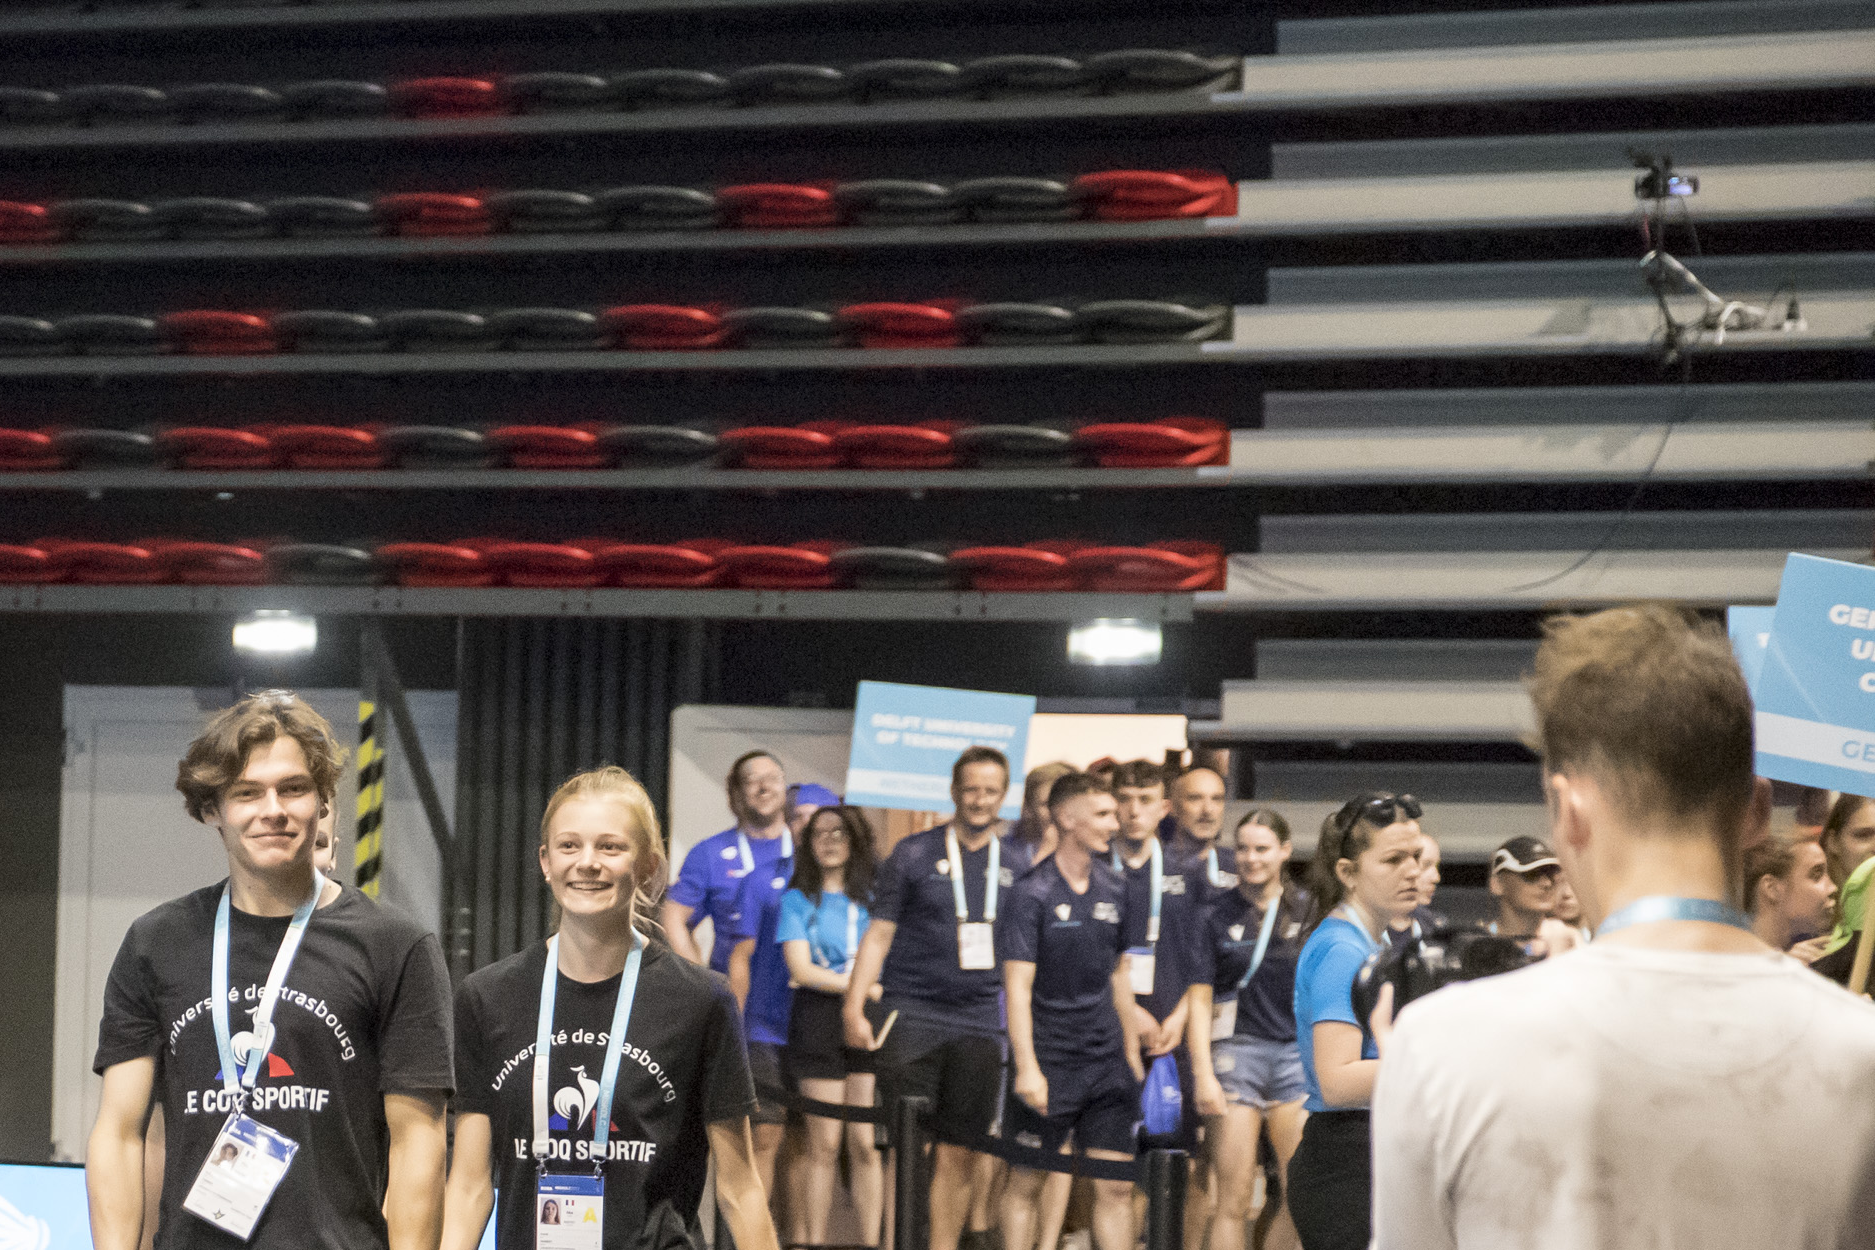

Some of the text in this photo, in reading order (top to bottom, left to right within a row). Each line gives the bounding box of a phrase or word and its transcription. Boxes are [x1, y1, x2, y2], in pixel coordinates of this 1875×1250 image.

[1828, 603, 1875, 631] GE
[278, 985, 356, 1062] trasbourg
[571, 1028, 595, 1044] de
[596, 1031, 677, 1104] Sasbourg
